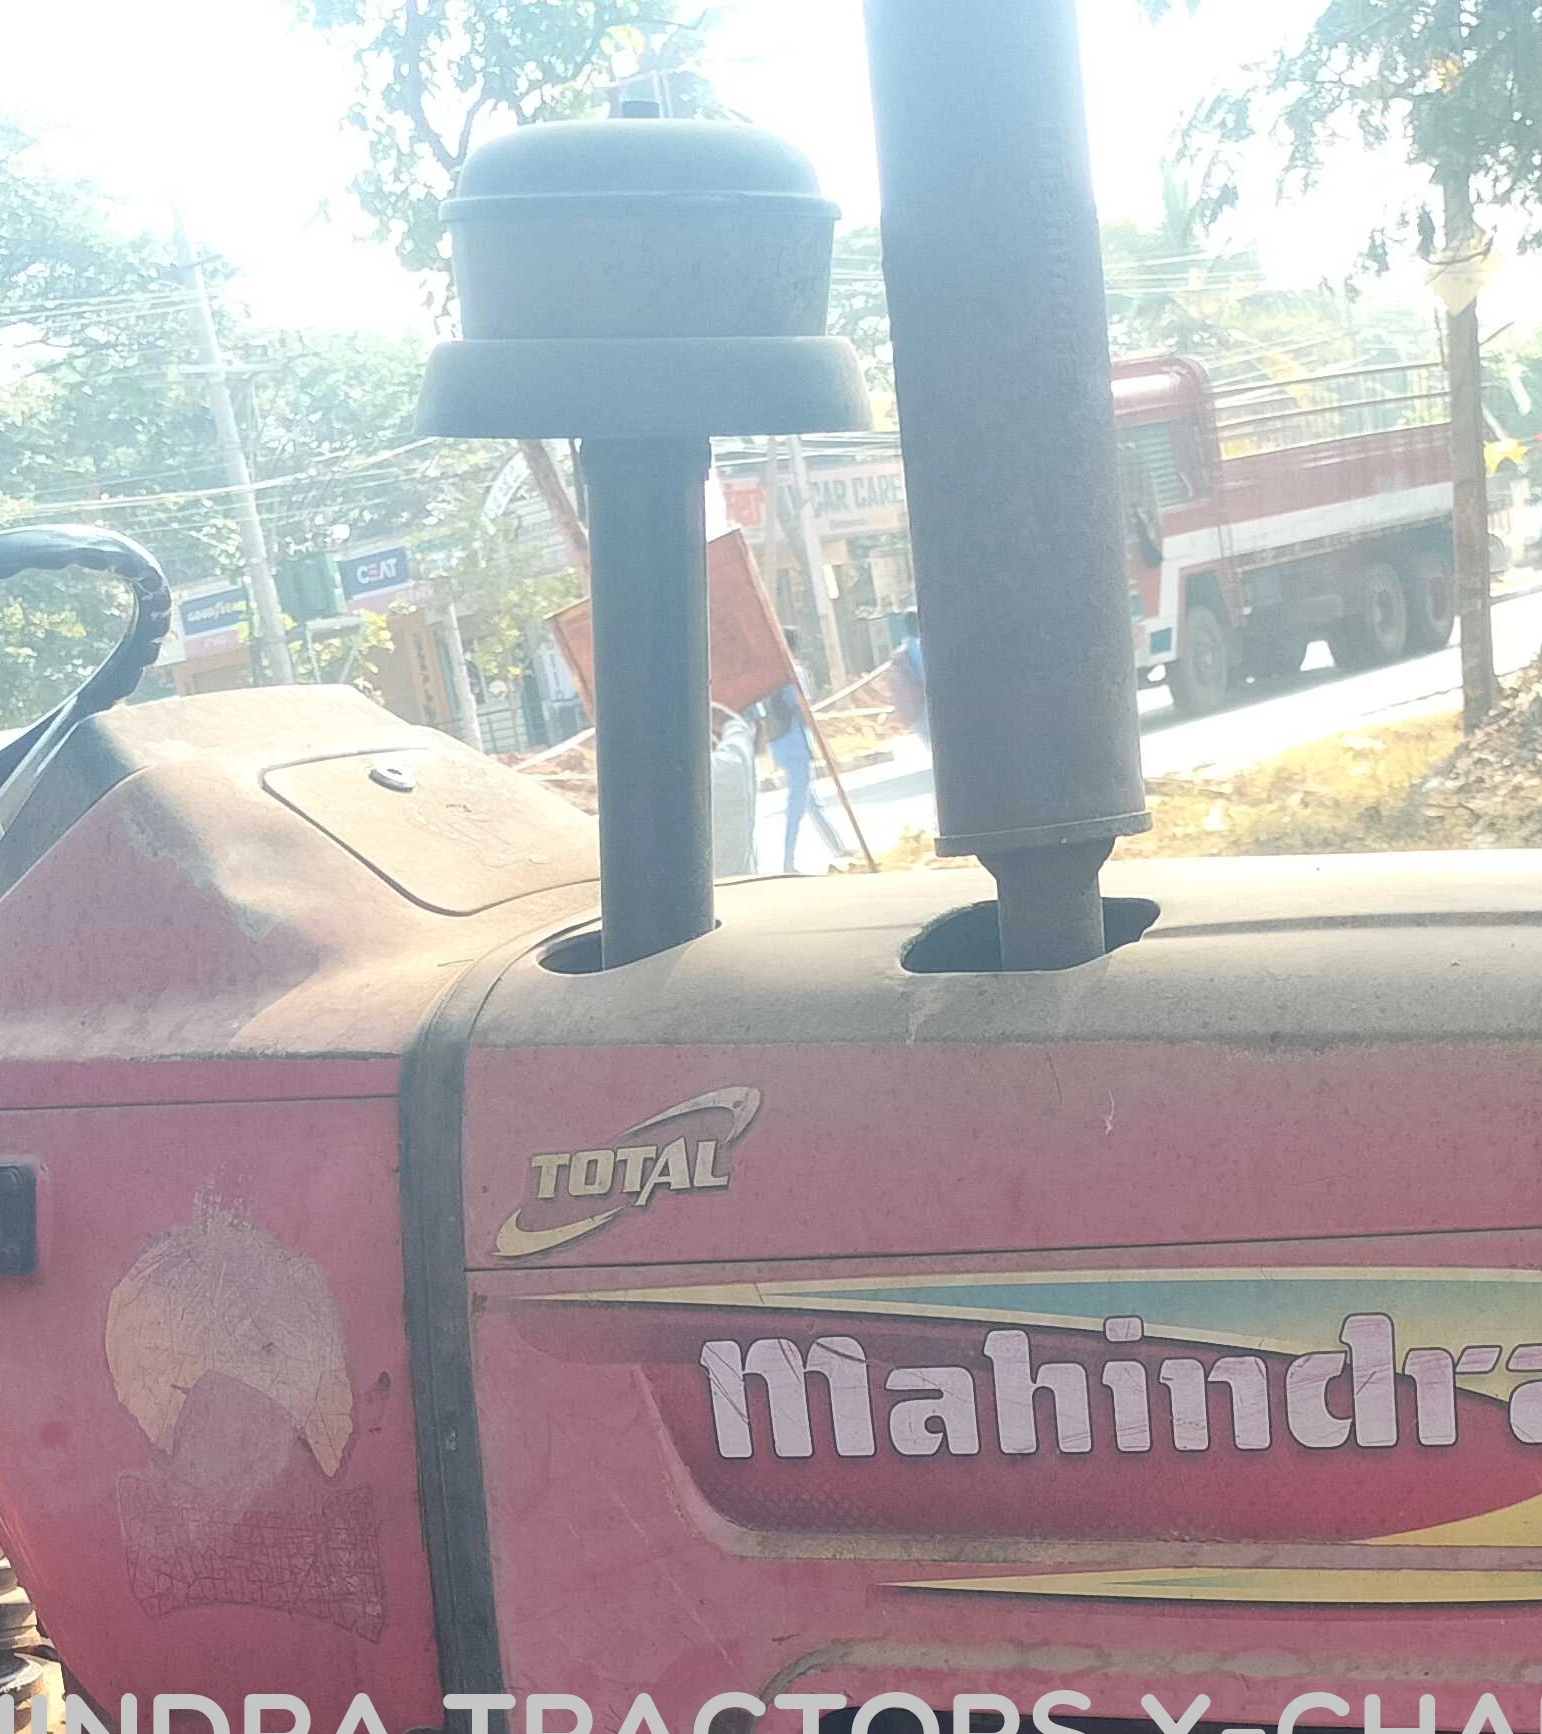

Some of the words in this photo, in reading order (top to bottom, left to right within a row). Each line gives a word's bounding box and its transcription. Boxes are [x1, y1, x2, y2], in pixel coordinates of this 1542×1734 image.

[851, 474, 904, 509] CARE
[356, 558, 398, 584] CEAT
[530, 1136, 730, 1206] TOTAL
